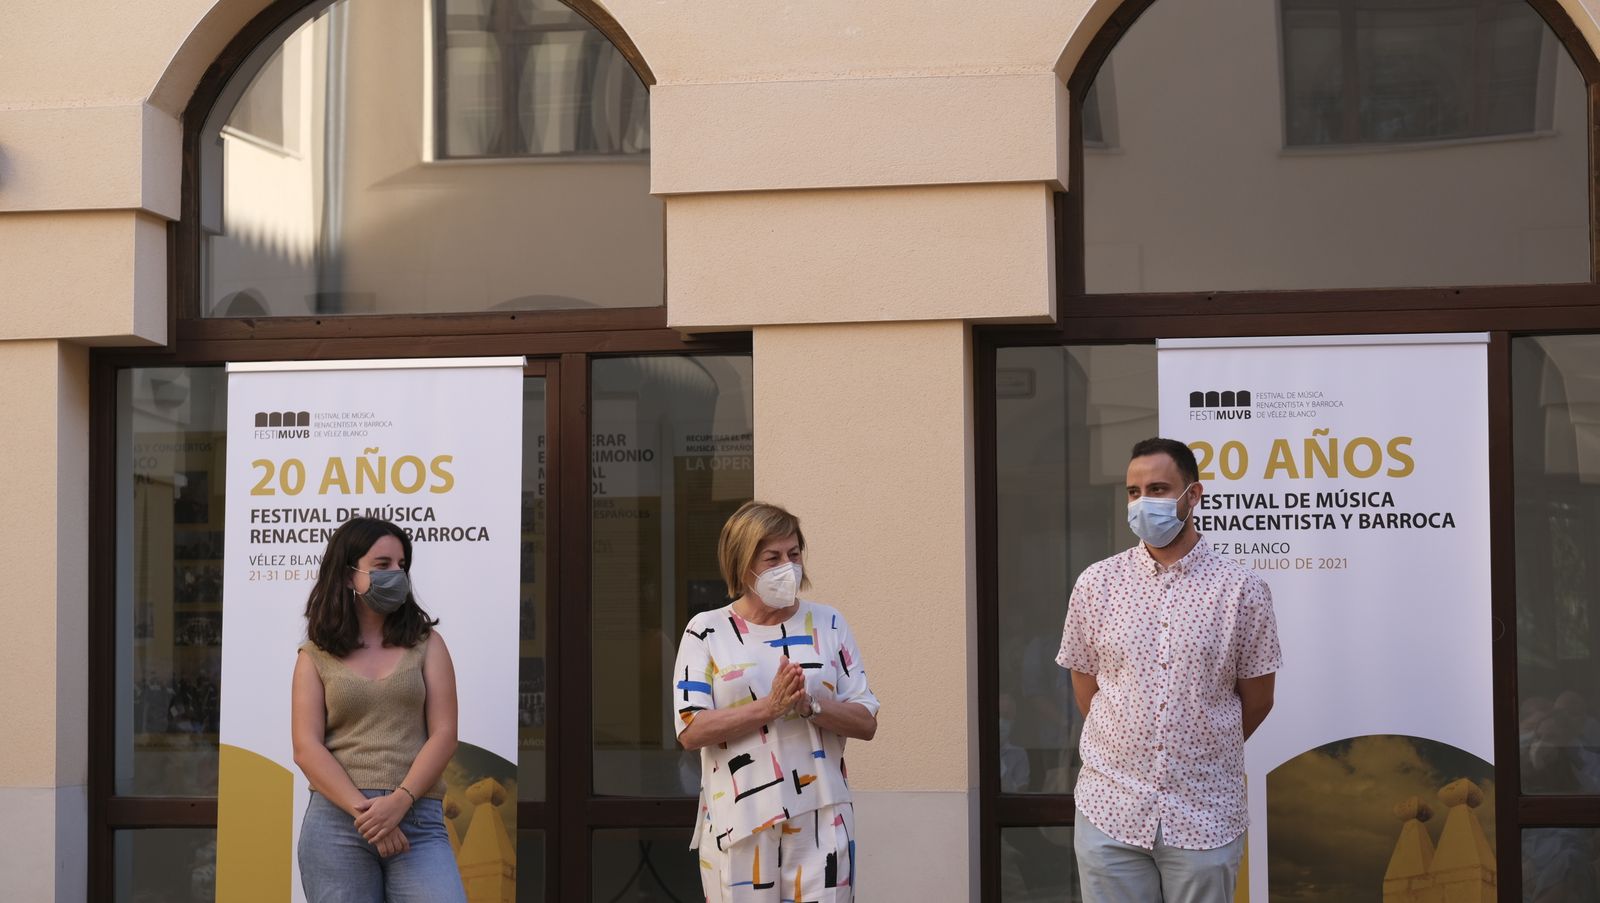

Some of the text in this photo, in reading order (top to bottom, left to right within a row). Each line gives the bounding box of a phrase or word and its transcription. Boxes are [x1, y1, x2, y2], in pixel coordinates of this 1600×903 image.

[1297, 390, 1324, 398] MÚSICA
[1256, 401, 1304, 409] RENACENTISTA
[1311, 400, 1344, 408] BARROCA
[314, 412, 340, 420] FESTIVAL
[351, 410, 375, 419] MÚSICA
[1189, 410, 1252, 420] FESTIMUVB
[1267, 410, 1287, 418] VÉLEZ
[1288, 410, 1317, 418] BLANCO
[363, 420, 393, 428] BARROCA
[254, 429, 310, 440] FESTIMUVB
[314, 430, 322, 438] DE
[324, 429, 342, 438] VÉLEZ
[1188, 428, 1415, 481] 20 AÑOS
[686, 456, 752, 471] LA OPER
[250, 446, 455, 496] 20 AÑOS
[1200, 489, 1395, 510] ESTIVAL DE MÚSICA
[250, 504, 436, 524] FESTIVAL DE MÚSICA
[1192, 512, 1456, 531] RENACENTISTA Y BARROCA
[250, 528, 340, 544] RENACEN
[1234, 542, 1290, 554] BLANCO
[249, 553, 322, 566] VÉLEZ BLAN
[1251, 558, 1290, 570] JULIO
[1295, 557, 1313, 570] DE
[1318, 557, 1348, 570] 2021
[249, 570, 279, 581] 21-31
[285, 569, 301, 581] DE
